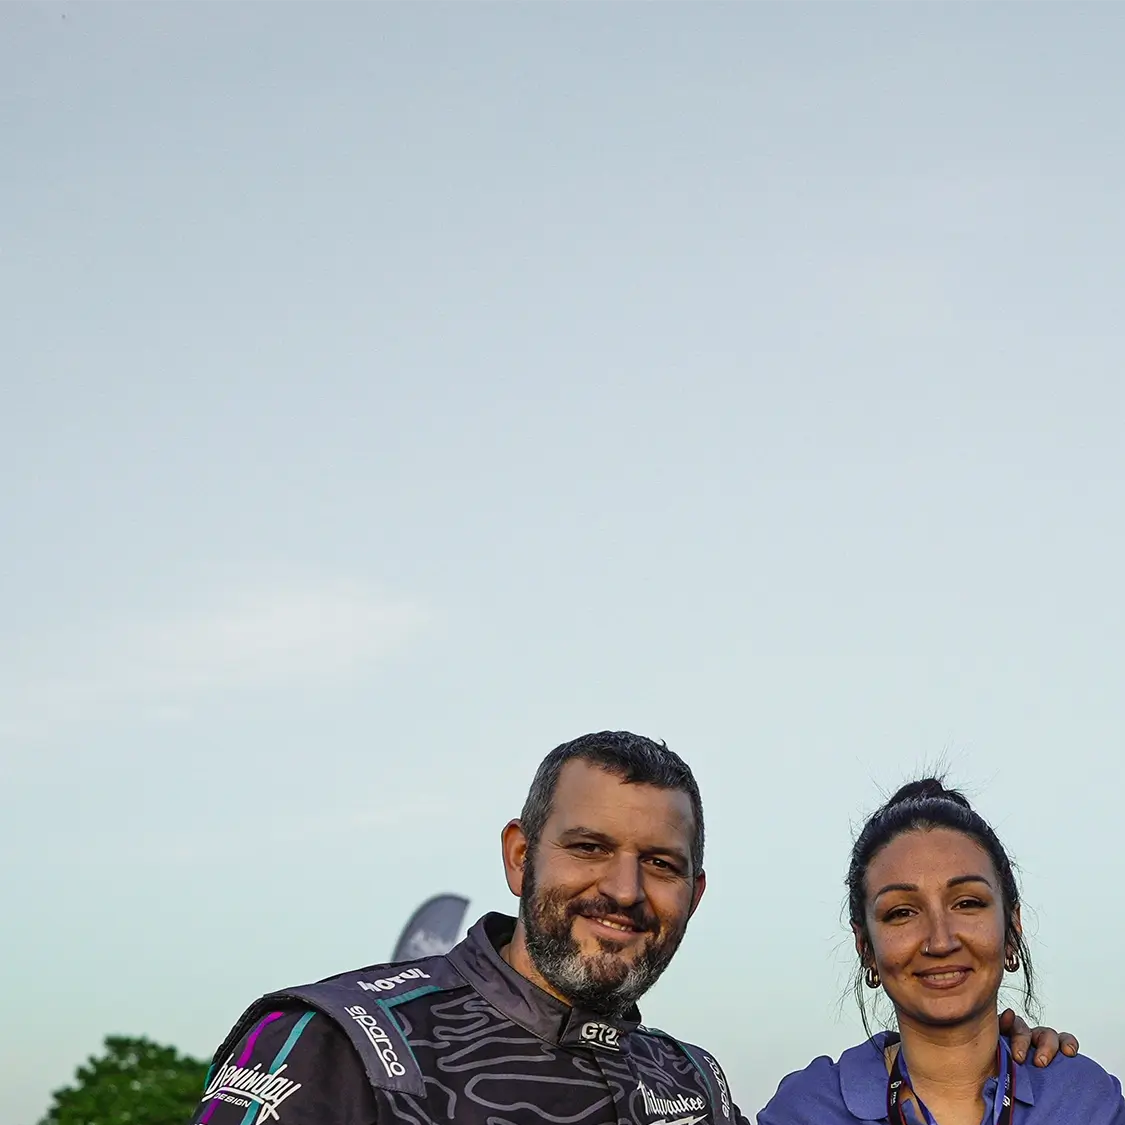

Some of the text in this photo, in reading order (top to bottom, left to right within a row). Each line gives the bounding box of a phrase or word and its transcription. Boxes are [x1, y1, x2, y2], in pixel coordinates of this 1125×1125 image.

[344, 1005, 406, 1077] sparco
[213, 1092, 251, 1108] DESIGN
[637, 1080, 706, 1116] Milwaukee
